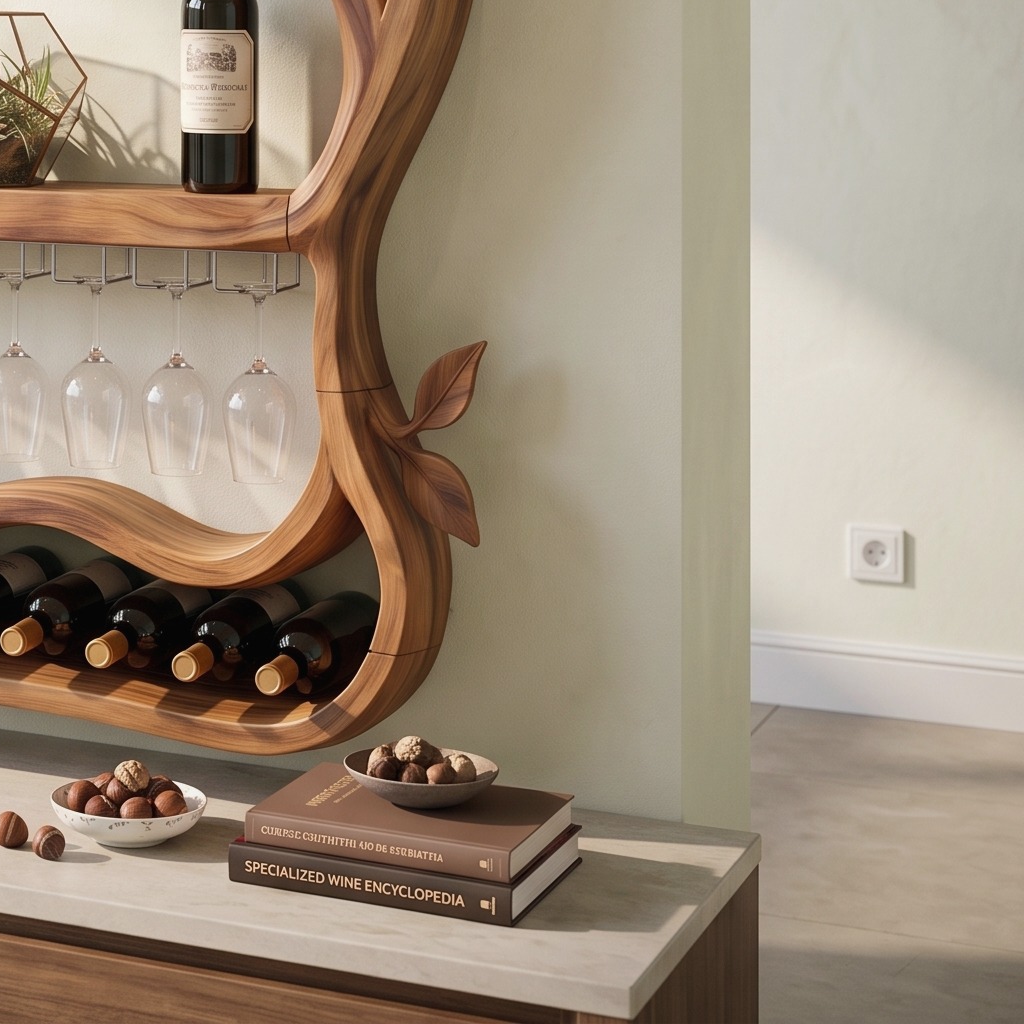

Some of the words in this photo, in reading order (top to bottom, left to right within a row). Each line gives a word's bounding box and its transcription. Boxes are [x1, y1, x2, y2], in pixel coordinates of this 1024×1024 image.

[375, 843, 388, 853] DE
[244, 860, 326, 885] SPECIALIZED
[328, 872, 363, 891] WINE
[364, 879, 465, 908] ENCYCLOPEDIA
